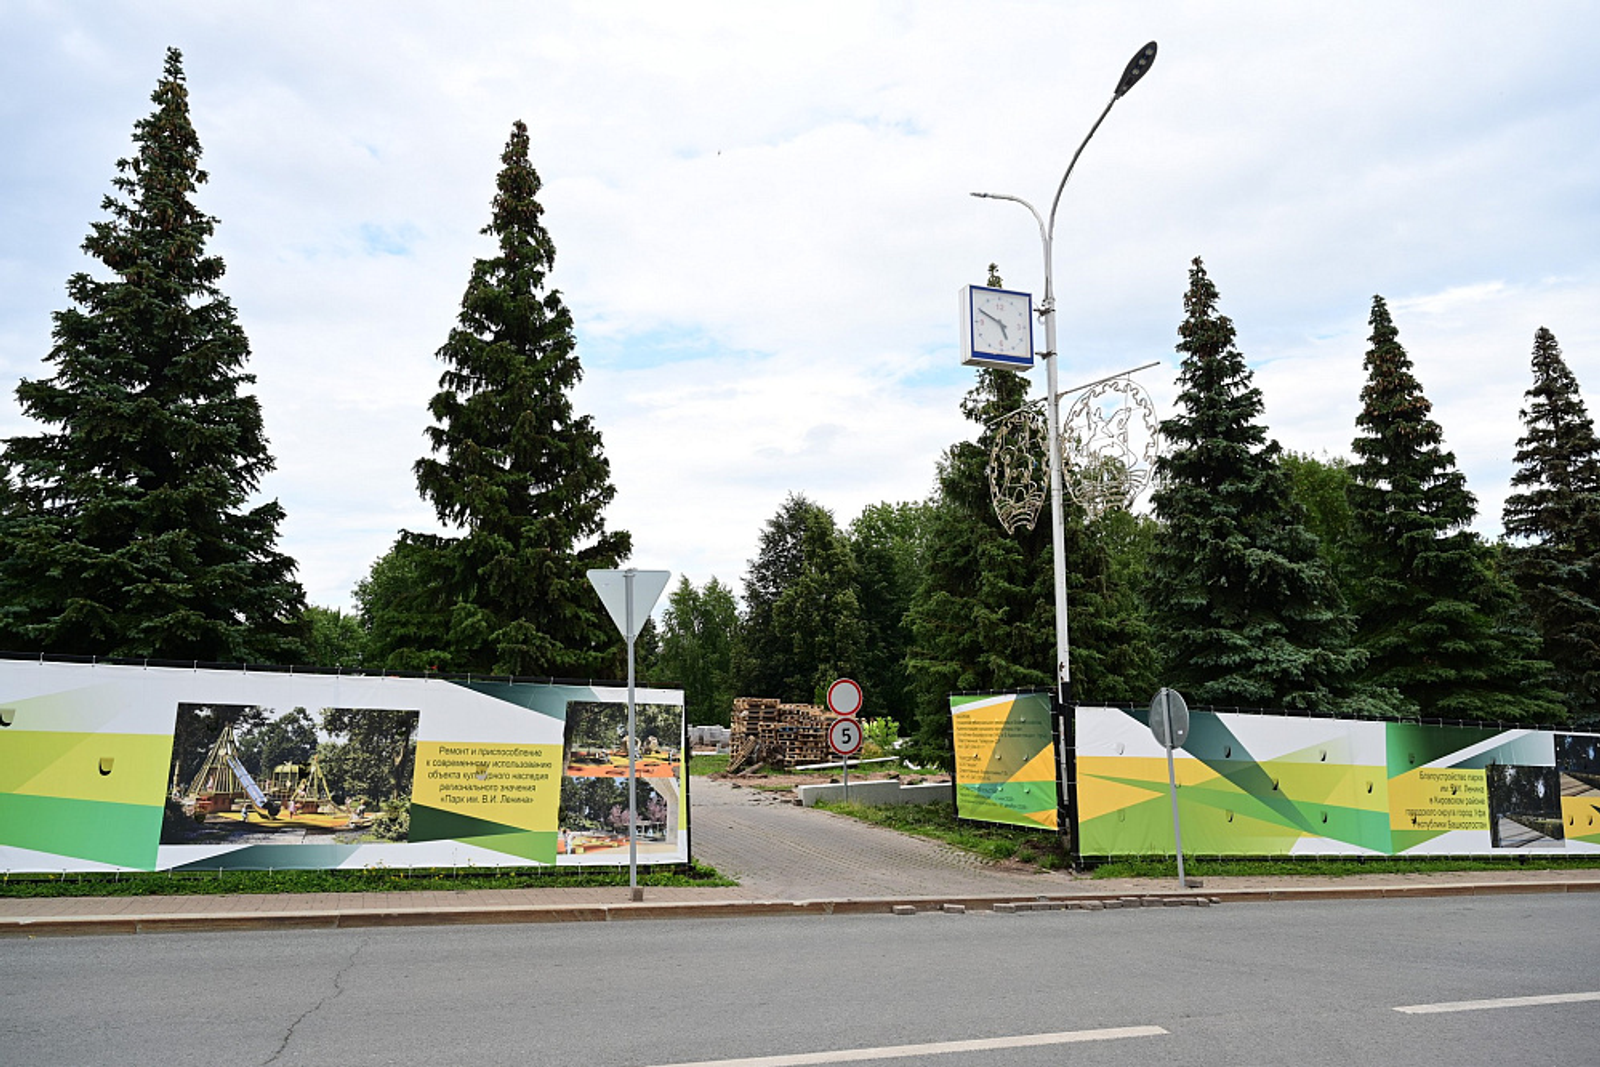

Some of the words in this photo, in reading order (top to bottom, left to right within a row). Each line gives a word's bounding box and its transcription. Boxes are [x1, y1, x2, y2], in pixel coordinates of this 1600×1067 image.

[996, 303, 1004, 311] 12
[842, 728, 852, 744] 5
[439, 745, 469, 756] Ремонт
[471, 748, 477, 756] и
[478, 747, 543, 757] приспособление
[492, 760, 552, 769] использованию
[428, 769, 461, 779] объекта
[512, 772, 549, 780] наследия
[439, 784, 498, 792] регионального
[500, 784, 536, 792] значения
[482, 794, 498, 803] В.И.
